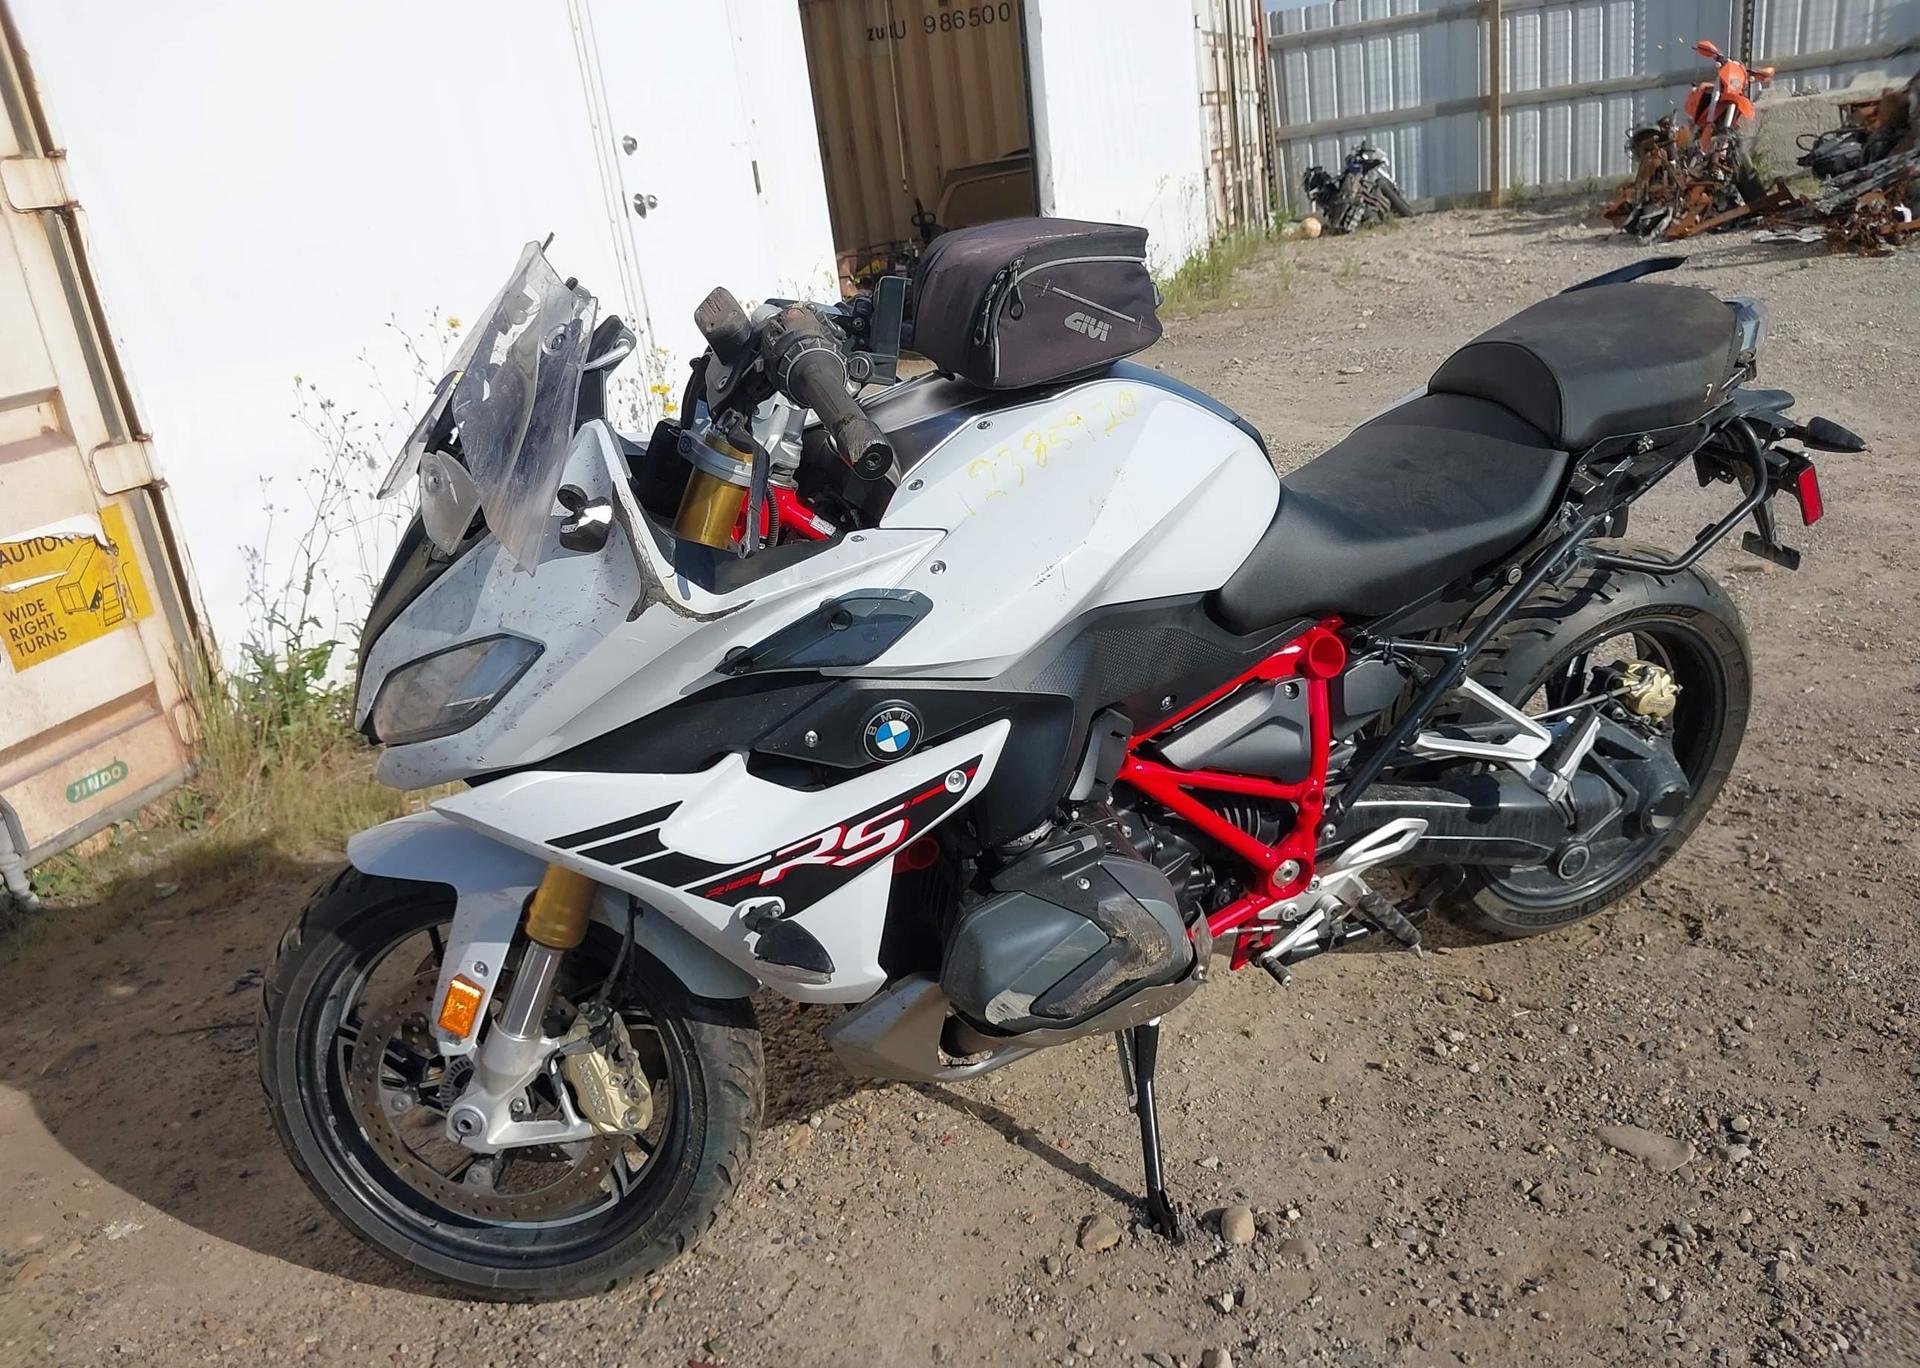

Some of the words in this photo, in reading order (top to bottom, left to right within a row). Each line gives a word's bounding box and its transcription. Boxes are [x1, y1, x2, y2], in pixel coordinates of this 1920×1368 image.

[923, 4, 1011, 34] 986500
[1064, 312, 1111, 342] GIVI
[2, 598, 47, 623] WIDE
[9, 613, 57, 642] RIGHT
[16, 627, 67, 657] TURNS
[866, 711, 910, 736] BMW
[73, 765, 122, 793] JINDO
[759, 801, 910, 887] RS
